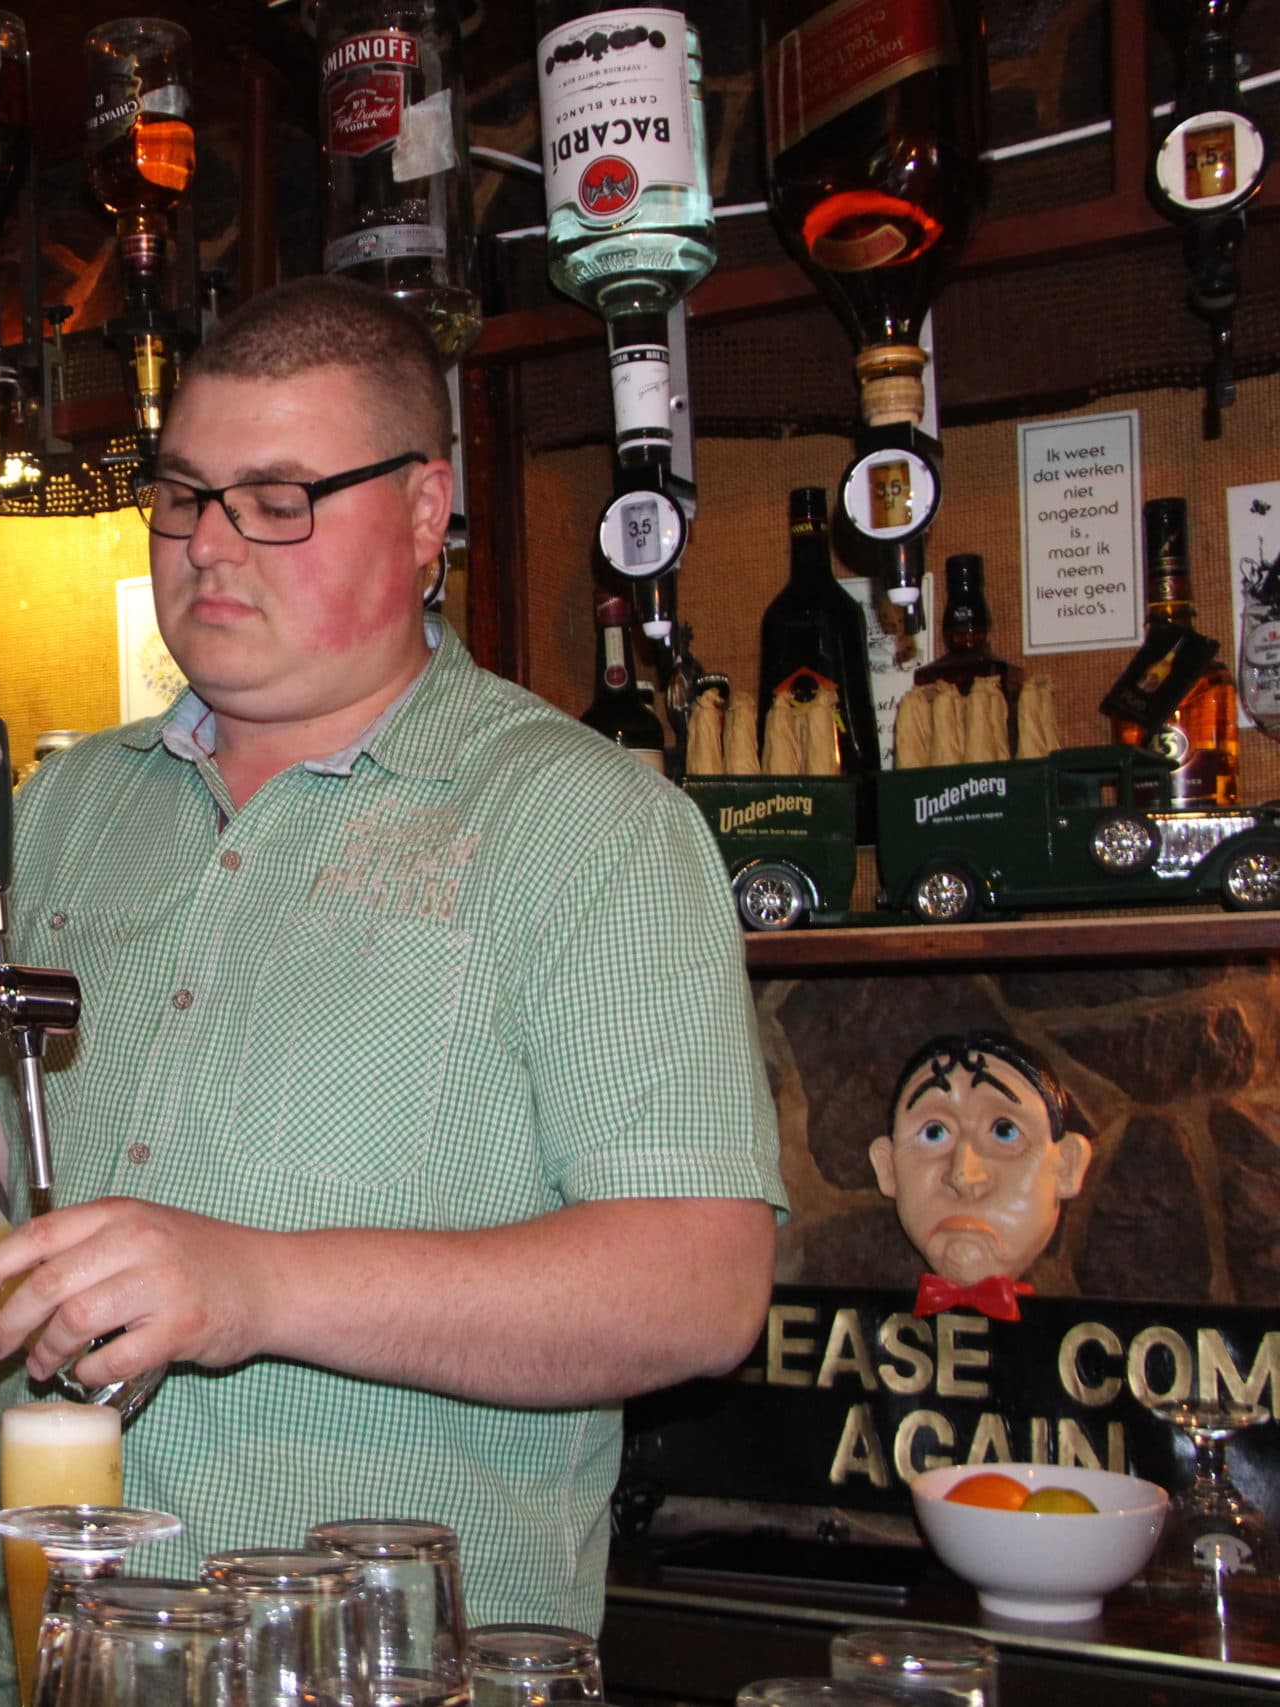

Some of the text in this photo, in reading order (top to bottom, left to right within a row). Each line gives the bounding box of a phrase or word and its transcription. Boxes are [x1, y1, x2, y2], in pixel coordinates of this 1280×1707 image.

[321, 38, 412, 81] SMIRNOFF
[99, 100, 138, 125] CHIVAS
[556, 95, 657, 125] CARTA BLANCA
[1046, 444, 1106, 463] Ik weet
[1033, 461, 1125, 484] dat werken
[876, 480, 902, 499] 3.5
[1063, 485, 1094, 500] niet
[1038, 501, 1119, 524] ongezond
[628, 518, 652, 538] 3.5
[636, 537, 646, 548] cl
[1048, 541, 1110, 560] maar ik
[1057, 564, 1104, 579] neem
[1036, 581, 1127, 600] liever geen
[914, 776, 1007, 824] Underberg
[720, 793, 814, 833] Underberg
[741, 1303, 990, 1398] EASE
[828, 1401, 1128, 1488] AGAIN
